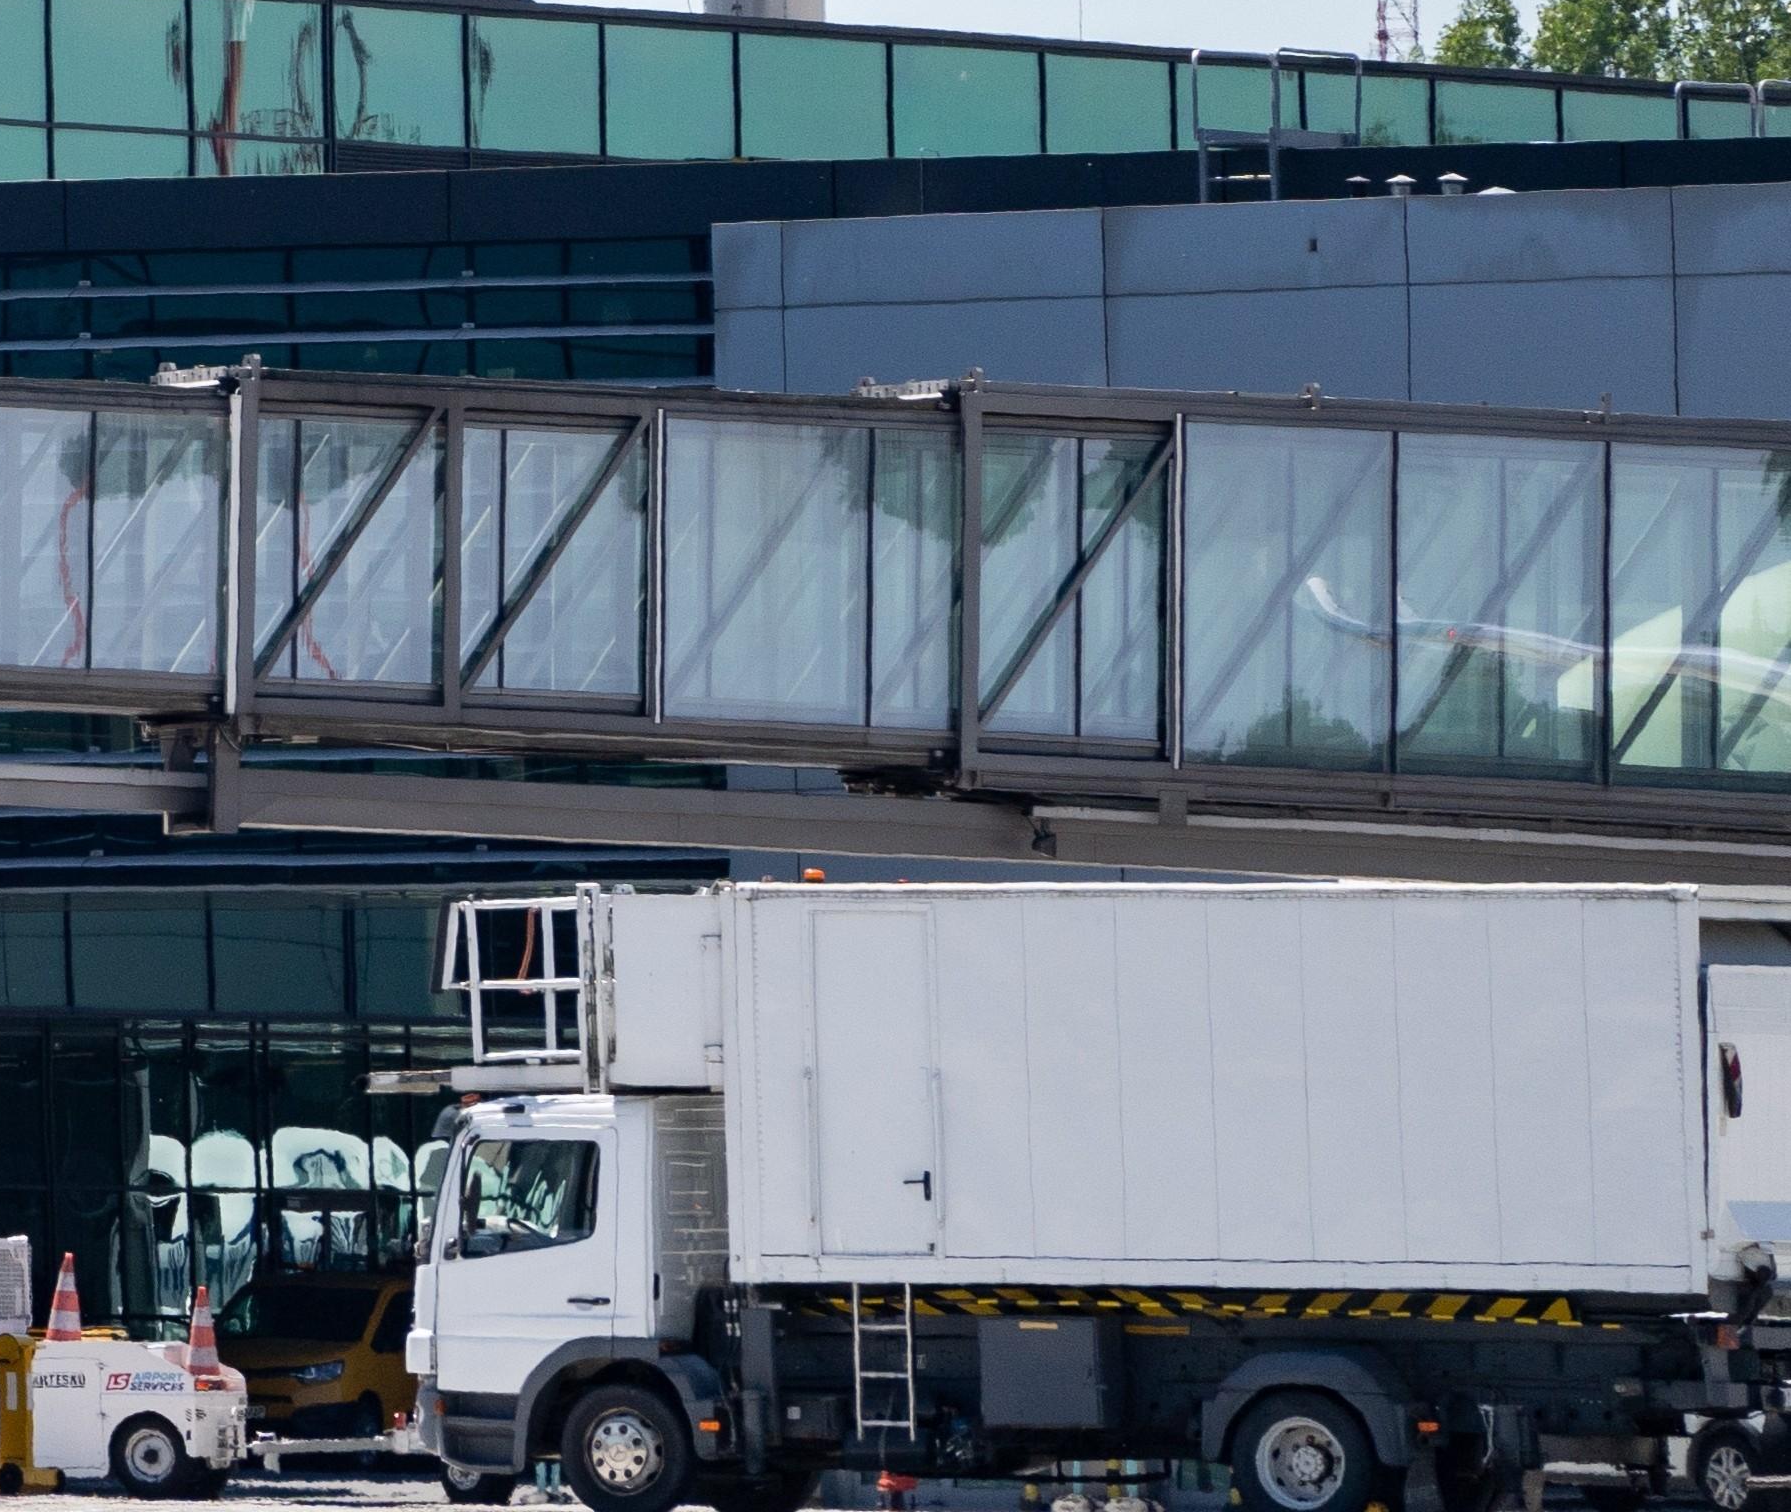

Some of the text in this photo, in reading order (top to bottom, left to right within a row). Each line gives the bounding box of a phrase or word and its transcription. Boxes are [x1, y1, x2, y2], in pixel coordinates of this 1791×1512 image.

[107, 1374, 130, 1390] LS
[134, 1372, 184, 1382] AIRPORT
[130, 1381, 185, 1392] SERVICES
